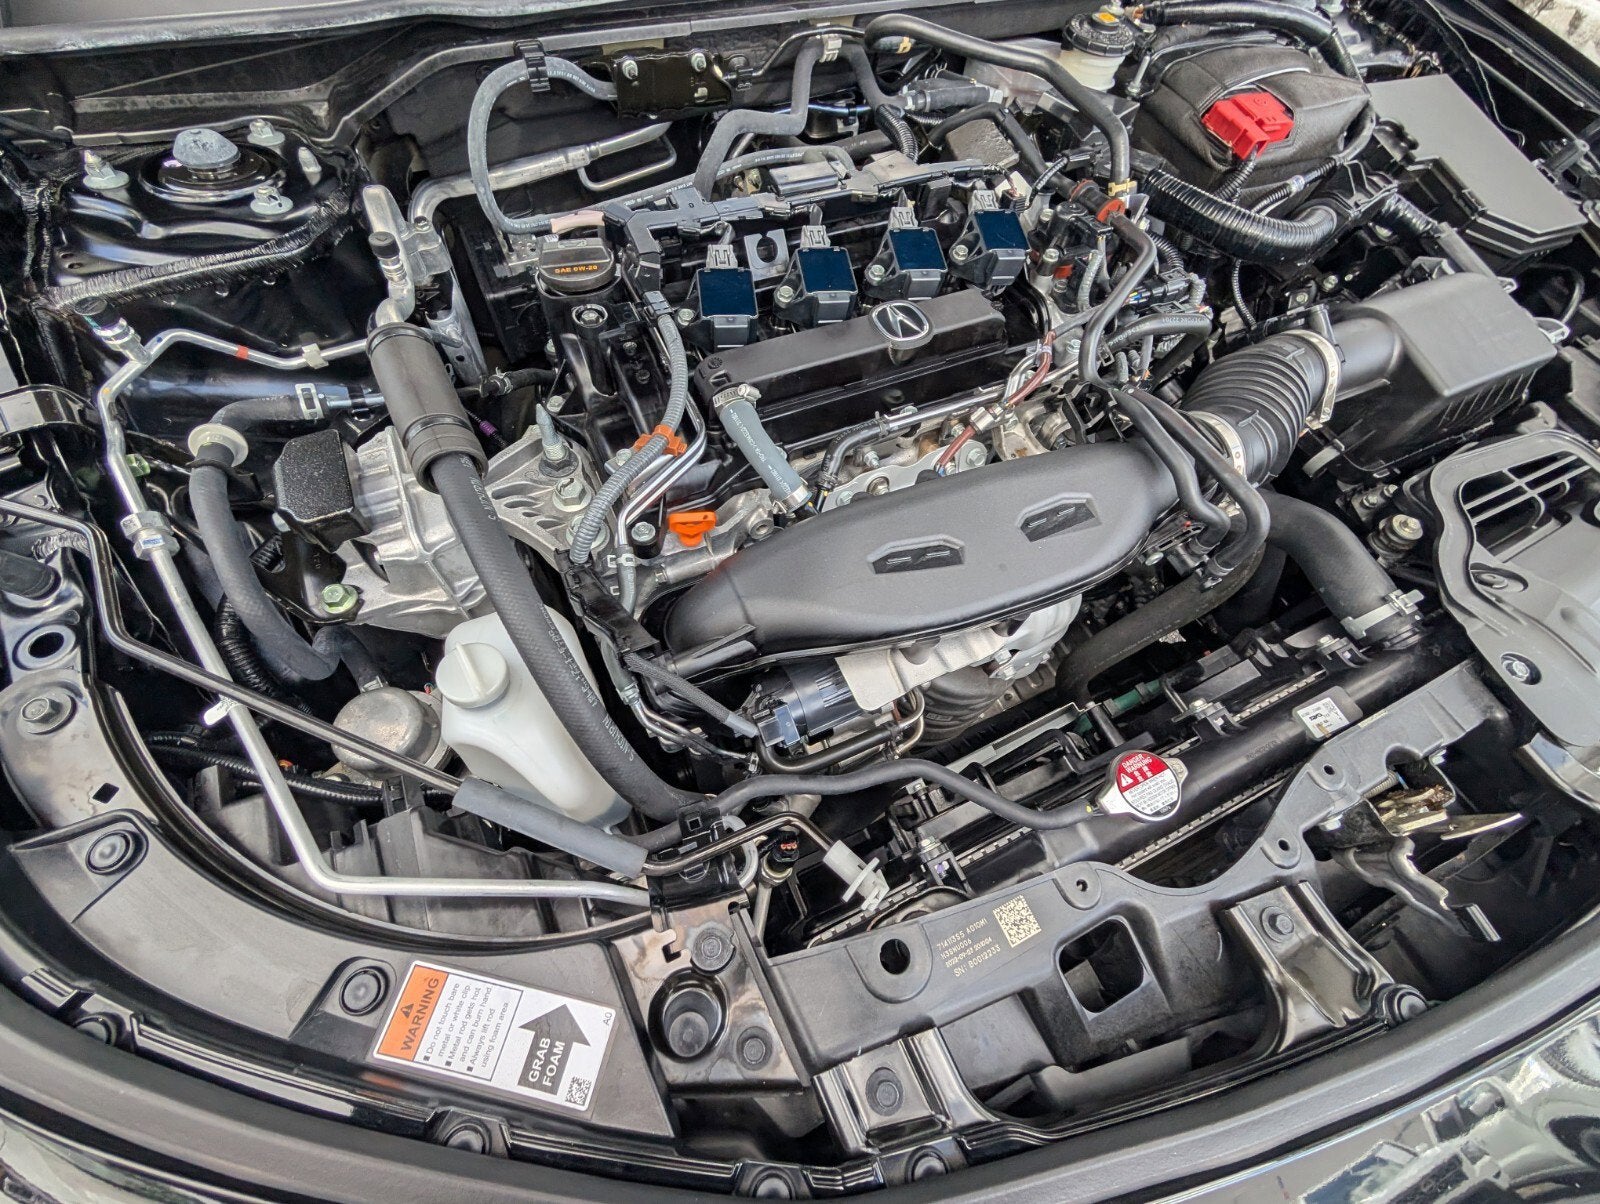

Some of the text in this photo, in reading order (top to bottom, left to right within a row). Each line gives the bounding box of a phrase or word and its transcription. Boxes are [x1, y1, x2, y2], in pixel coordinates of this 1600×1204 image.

[1122, 754, 1143, 768] DANGER
[1125, 757, 1152, 773] WARNING
[401, 976, 439, 1052] WARNING
[427, 982, 459, 1054] Do not touch bare
[437, 1033, 451, 1056] metal
[449, 1023, 454, 1031] or
[452, 1000, 464, 1021] white
[448, 986, 481, 1059] Metal rod gets hot
[459, 1045, 469, 1061] and
[467, 1028, 476, 1043] can
[473, 1008, 483, 1027] burn
[470, 1035, 486, 1064] Always
[486, 1008, 495, 1021] rod
[480, 1044, 494, 1067] using
[489, 1021, 501, 1043] foam
[528, 1036, 551, 1081] GRAB
[543, 1040, 565, 1086] FOAM
